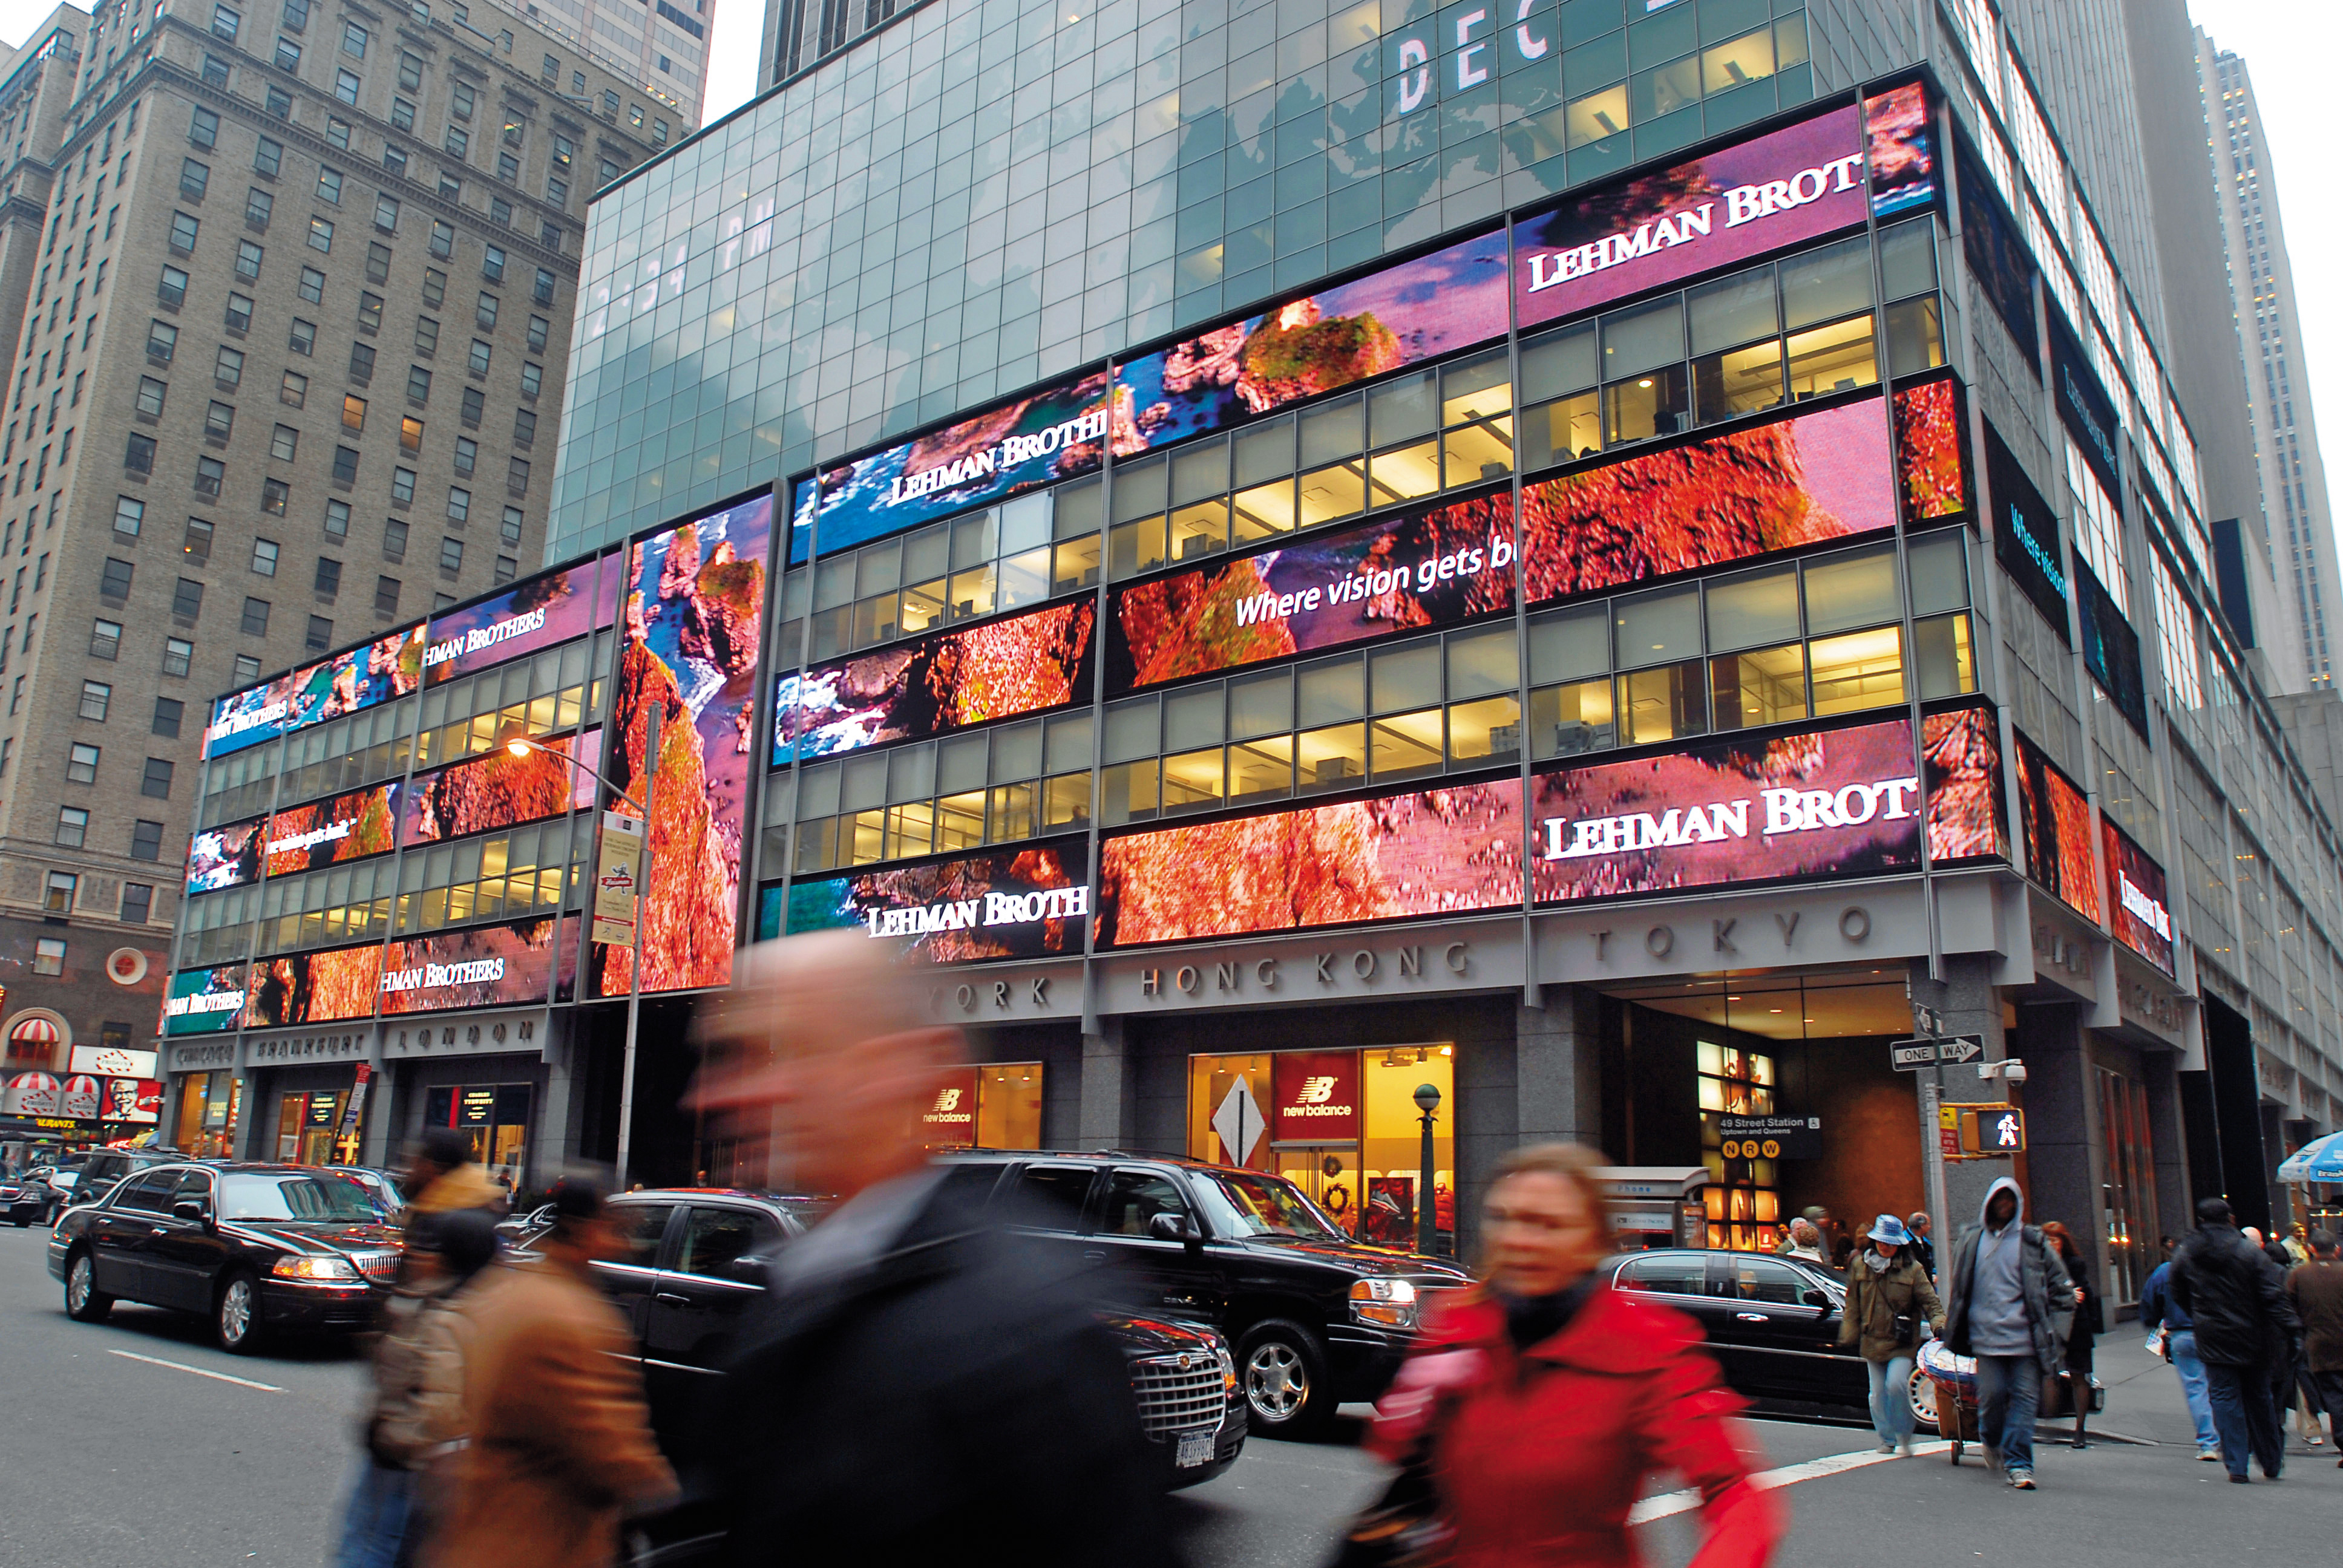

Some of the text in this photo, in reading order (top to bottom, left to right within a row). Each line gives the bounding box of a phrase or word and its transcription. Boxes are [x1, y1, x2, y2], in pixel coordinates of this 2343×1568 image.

[1399, 0, 1547, 113] DEC
[724, 198, 774, 270] PM
[1527, 152, 1864, 293] LEHMAN BROT
[886, 446, 998, 508] LEHMAN
[2010, 503, 2041, 566] Where
[1236, 587, 1320, 627] Where
[1328, 565, 1410, 605] vision
[1417, 547, 1483, 593] gets
[465, 608, 545, 653] BROTHERS
[1544, 777, 1921, 861] LEHMAN BROT
[867, 886, 1089, 938] LEHMAN BROTH
[1590, 905, 1871, 961] TOKYO
[424, 956, 505, 988] BROTHERS
[1141, 941, 1468, 996] HONG KONG
[188, 989, 245, 1014] BROTHERS
[398, 1021, 534, 1051] LONDON
[1904, 1044, 1969, 1061] ONE WAY
[923, 1112, 971, 1123] new balance
[1283, 1104, 1352, 1117] new balance
[1720, 1118, 1804, 1128] 49 Street Station
[1765, 1143, 1777, 1154] W
